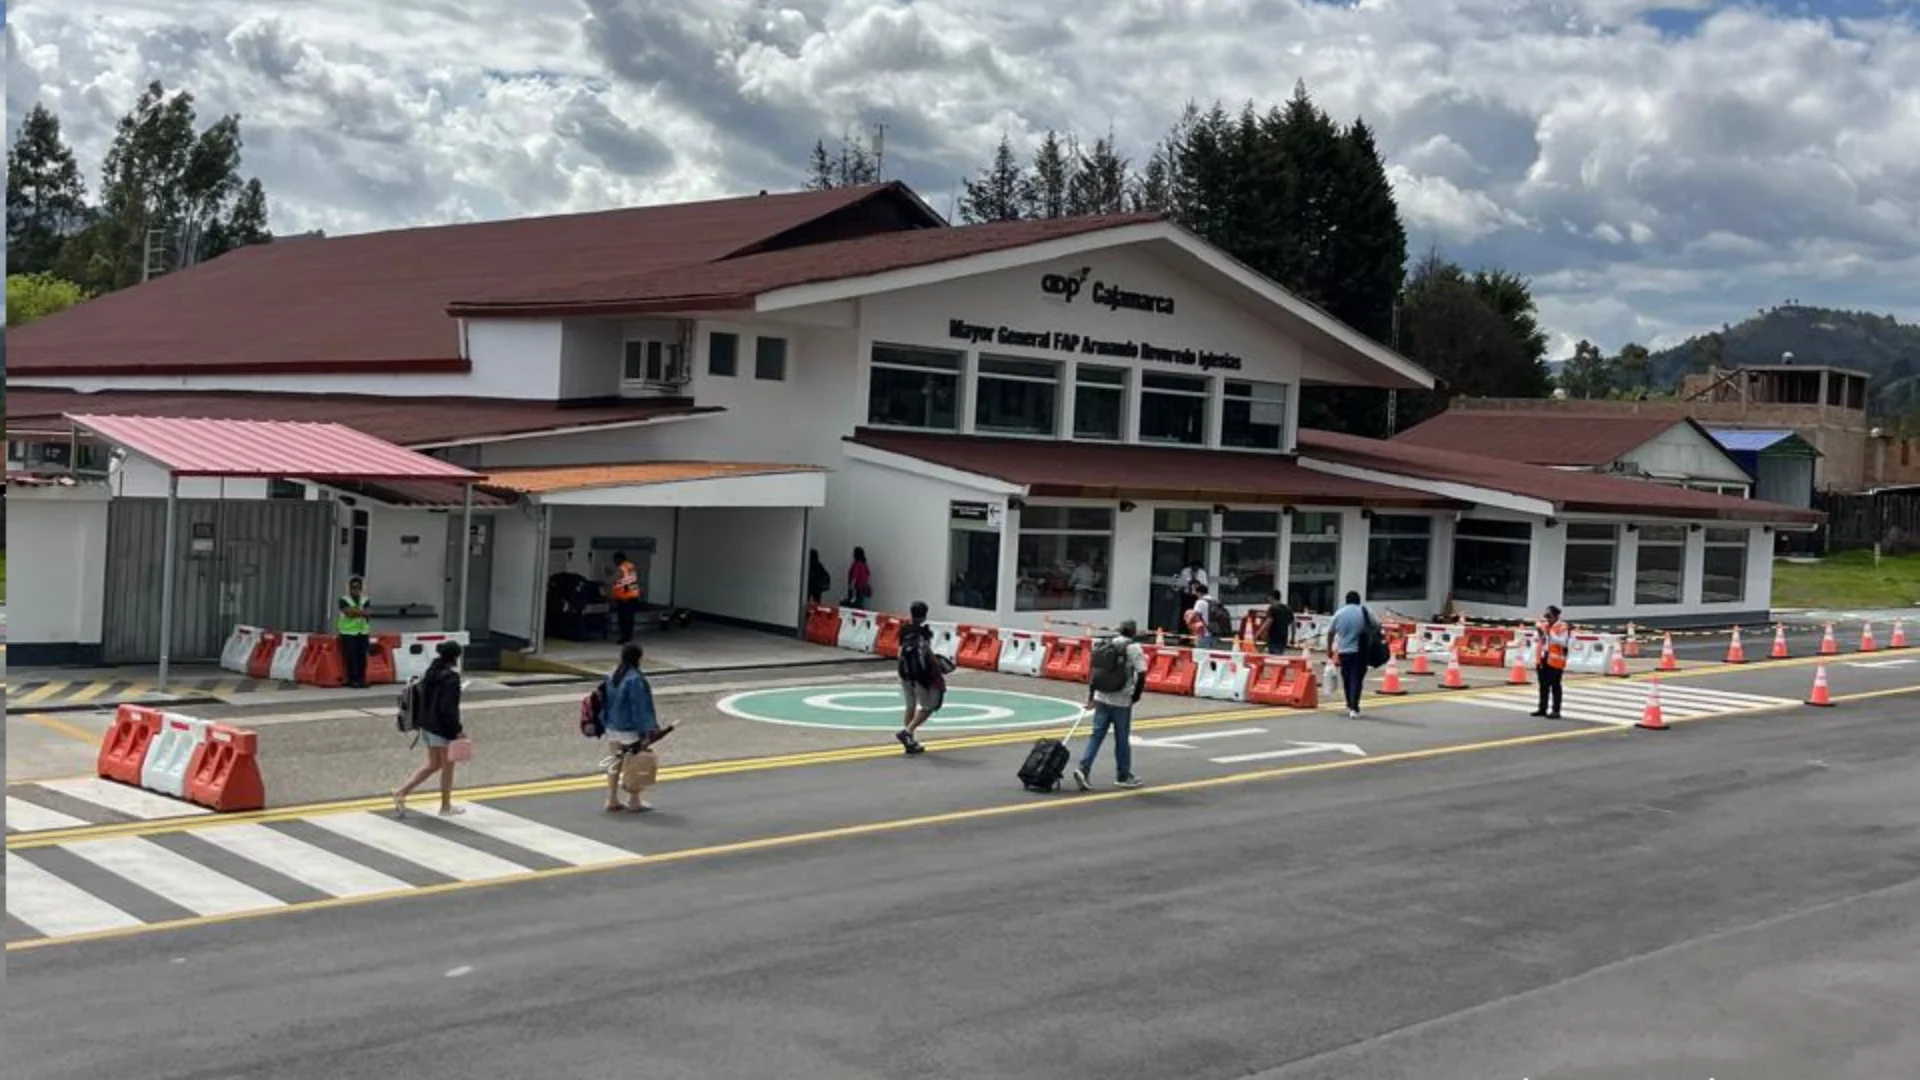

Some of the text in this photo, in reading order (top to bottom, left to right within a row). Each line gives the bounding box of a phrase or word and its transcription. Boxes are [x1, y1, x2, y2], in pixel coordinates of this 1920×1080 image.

[1092, 281, 1174, 314] Cajamarca
[949, 318, 995, 344] Mayor
[997, 326, 1051, 349] General
[1053, 332, 1080, 352] FAP
[1081, 336, 1138, 358] Armando
[1198, 349, 1242, 371] Iglesias
